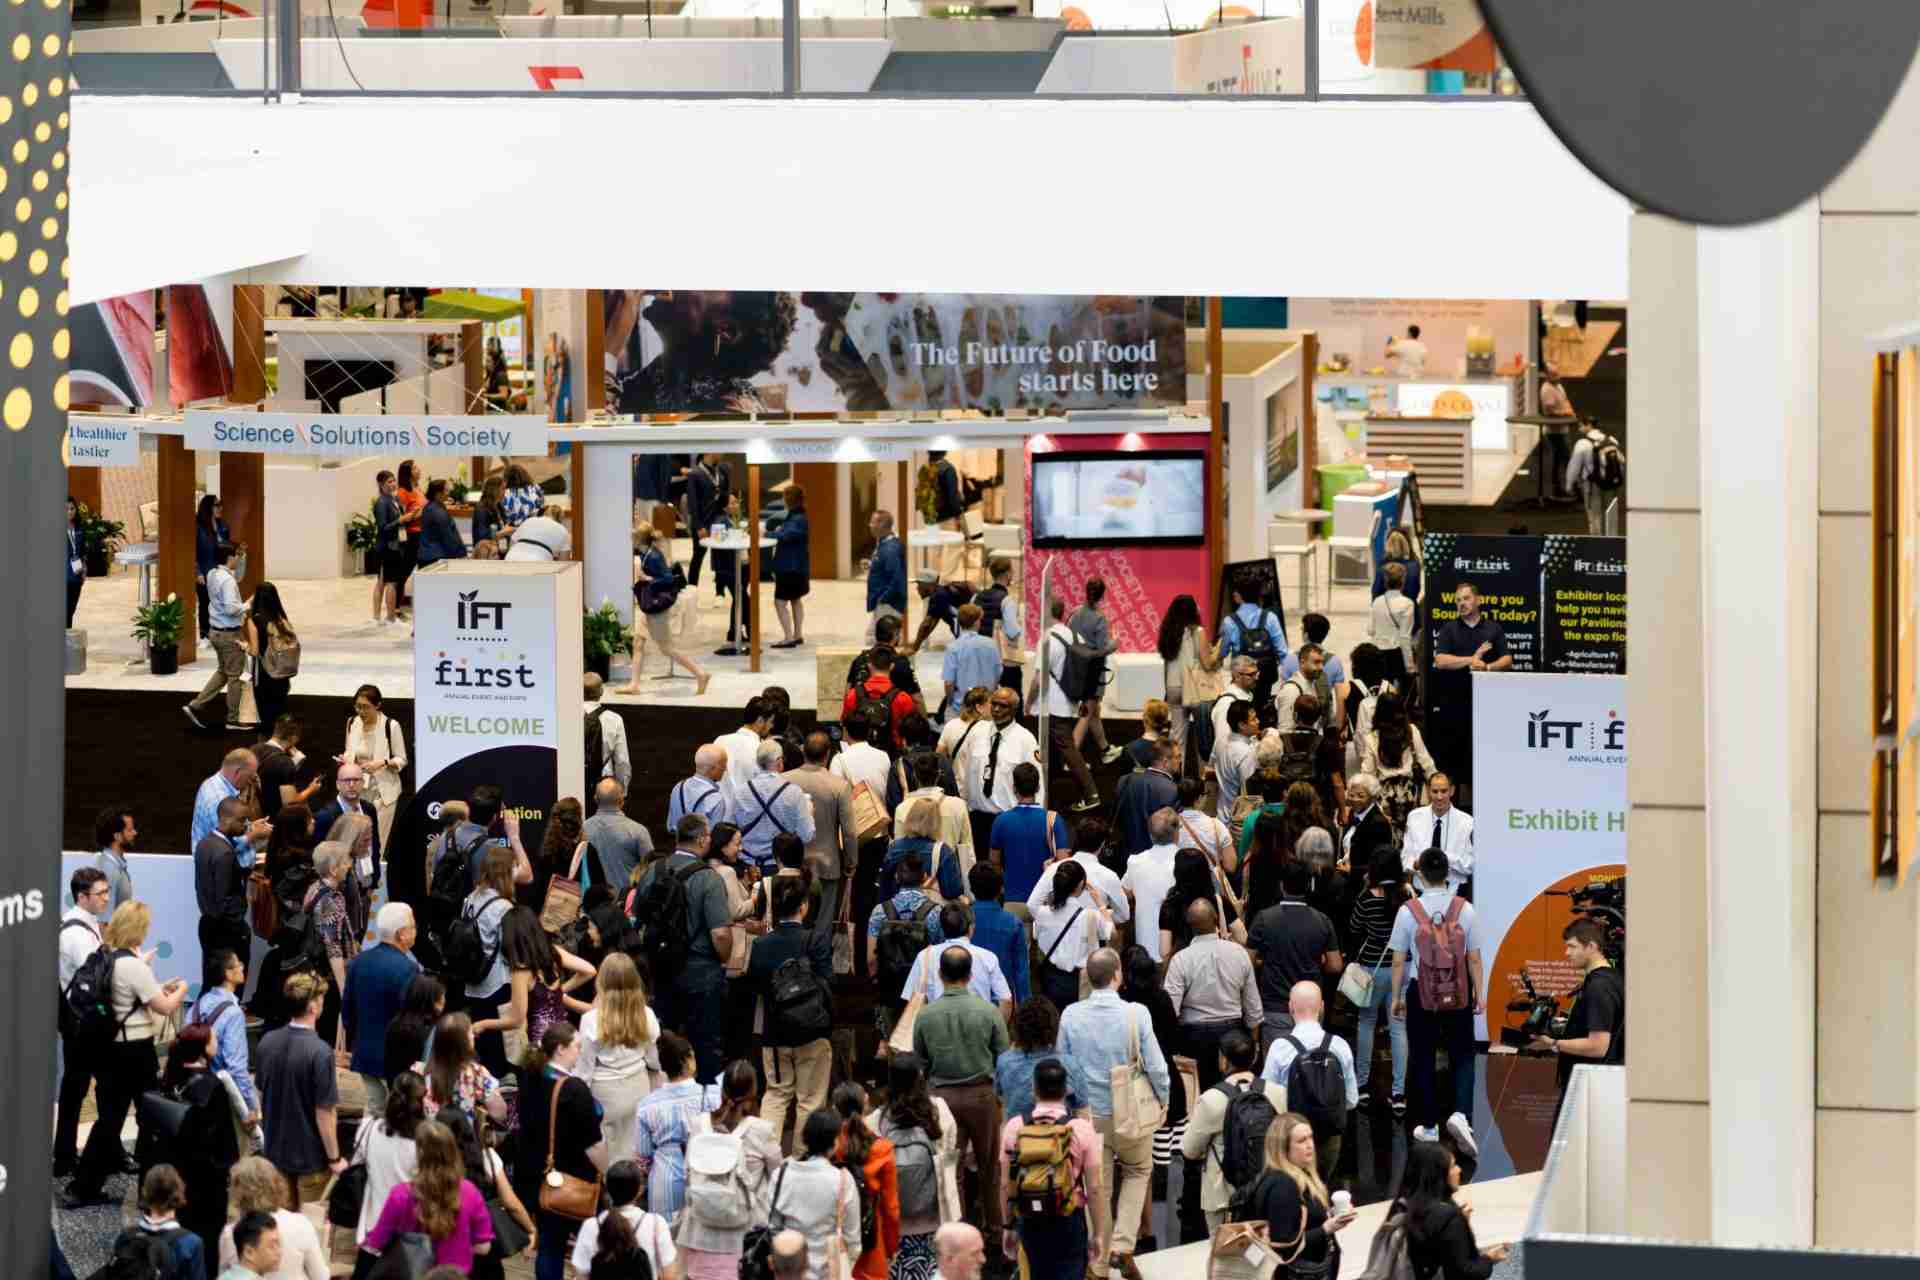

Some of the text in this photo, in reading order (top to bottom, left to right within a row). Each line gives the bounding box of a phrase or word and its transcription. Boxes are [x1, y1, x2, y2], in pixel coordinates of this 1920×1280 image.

[910, 339, 1157, 365] The Future of Food
[1018, 369, 1159, 393] starts here
[214, 421, 511, 450] Science Solutions Society
[72, 445, 111, 459] tastier
[1501, 596, 1524, 607] you
[1556, 591, 1603, 601] Exhibitor
[457, 593, 512, 631] IFT
[1492, 608, 1537, 623] Today?
[1556, 603, 1579, 615] help
[1582, 606, 1601, 616] you
[1560, 618, 1578, 627] our
[1564, 631, 1582, 641] the
[1584, 633, 1610, 644] expo
[435, 655, 535, 689] first
[427, 715, 545, 736] WELCOME
[1528, 715, 1583, 749] IFT
[1567, 755, 1604, 764] ANNUAL
[1507, 808, 1599, 832] Exhibit
